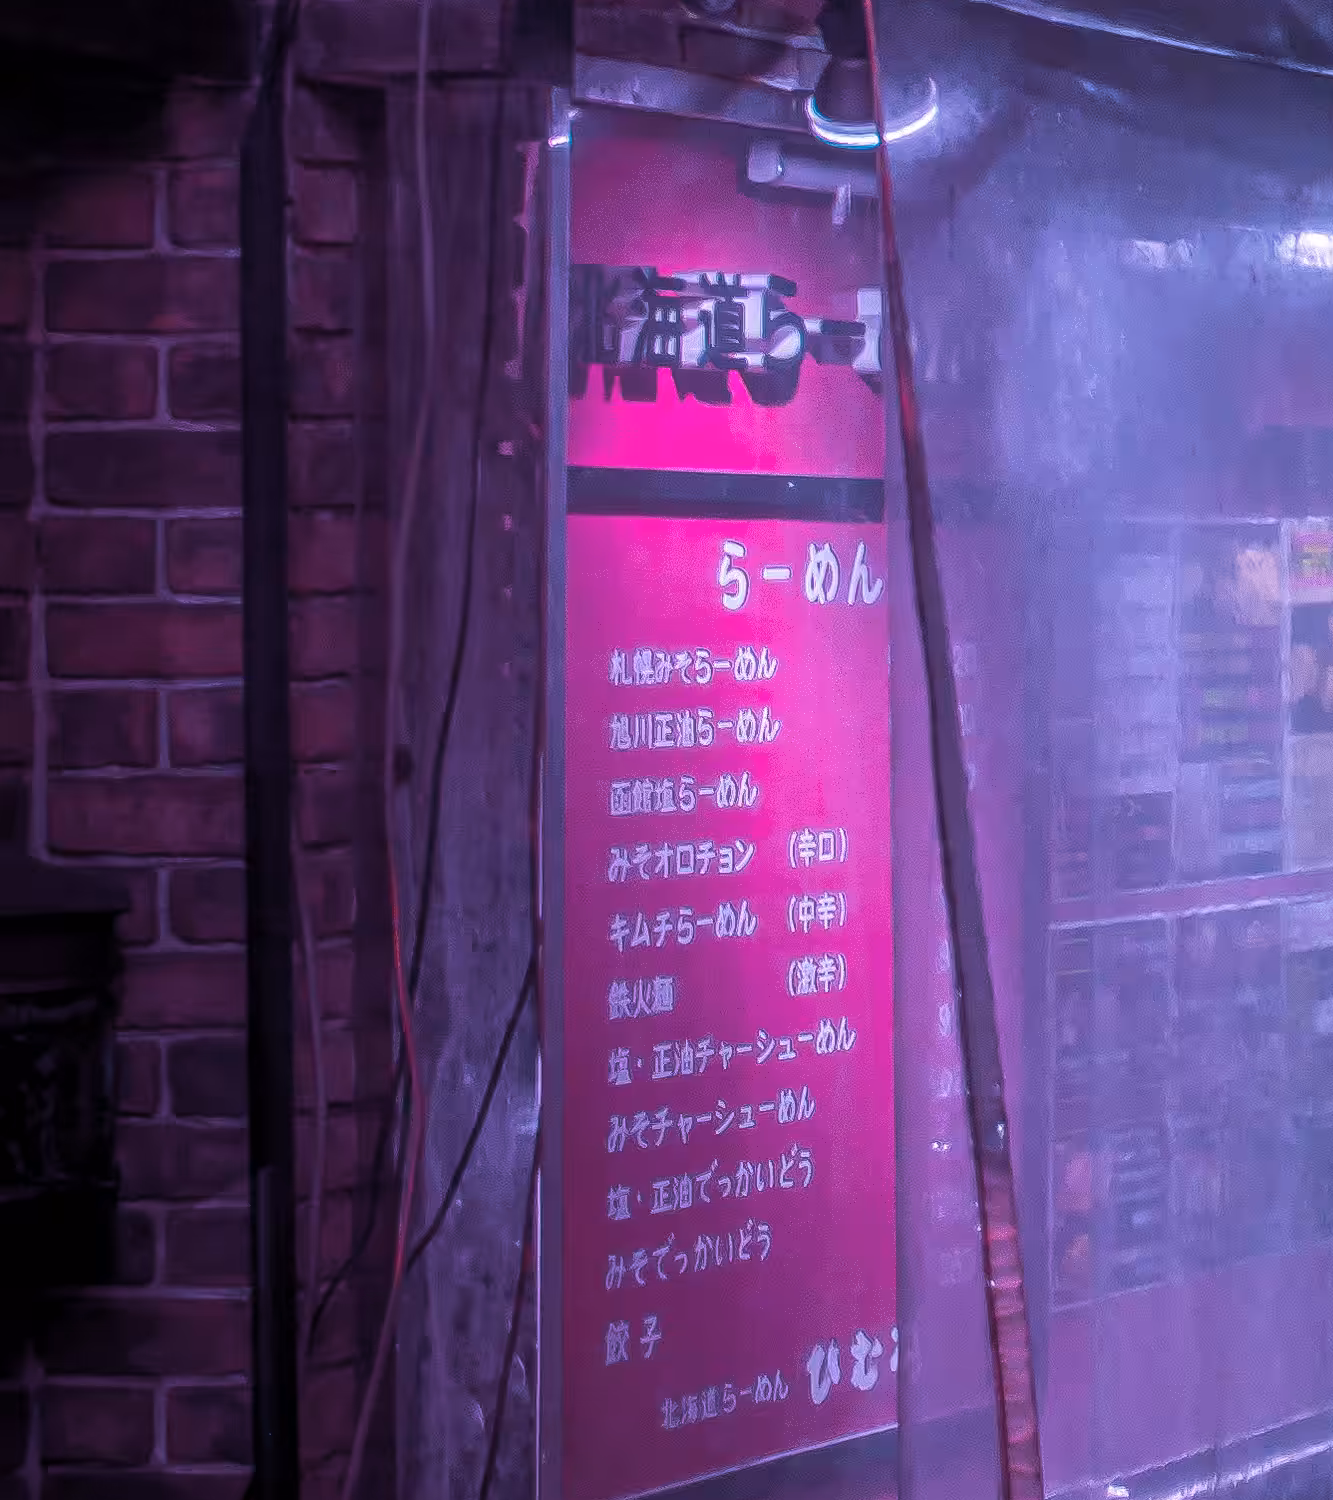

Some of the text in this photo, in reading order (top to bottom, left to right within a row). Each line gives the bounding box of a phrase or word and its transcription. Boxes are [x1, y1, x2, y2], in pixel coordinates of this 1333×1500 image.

[719, 540, 884, 611] らーめん
[608, 646, 779, 686] 札幌みそらーめん
[608, 707, 782, 750] 旭川正油らーめん
[610, 771, 759, 816] 函館塩らーめん
[607, 827, 847, 883] みそオロチョン (辛口)
[608, 892, 847, 952] キムチらーめん (中辛)
[788, 952, 847, 998] (激辛)
[607, 1016, 857, 1086] 塩・正油チャーシューめん
[607, 1085, 816, 1153] みそチャーシューめん
[605, 1217, 772, 1291] みそでっかいどう
[660, 1324, 899, 1430] 北海道らーめん ひむ
